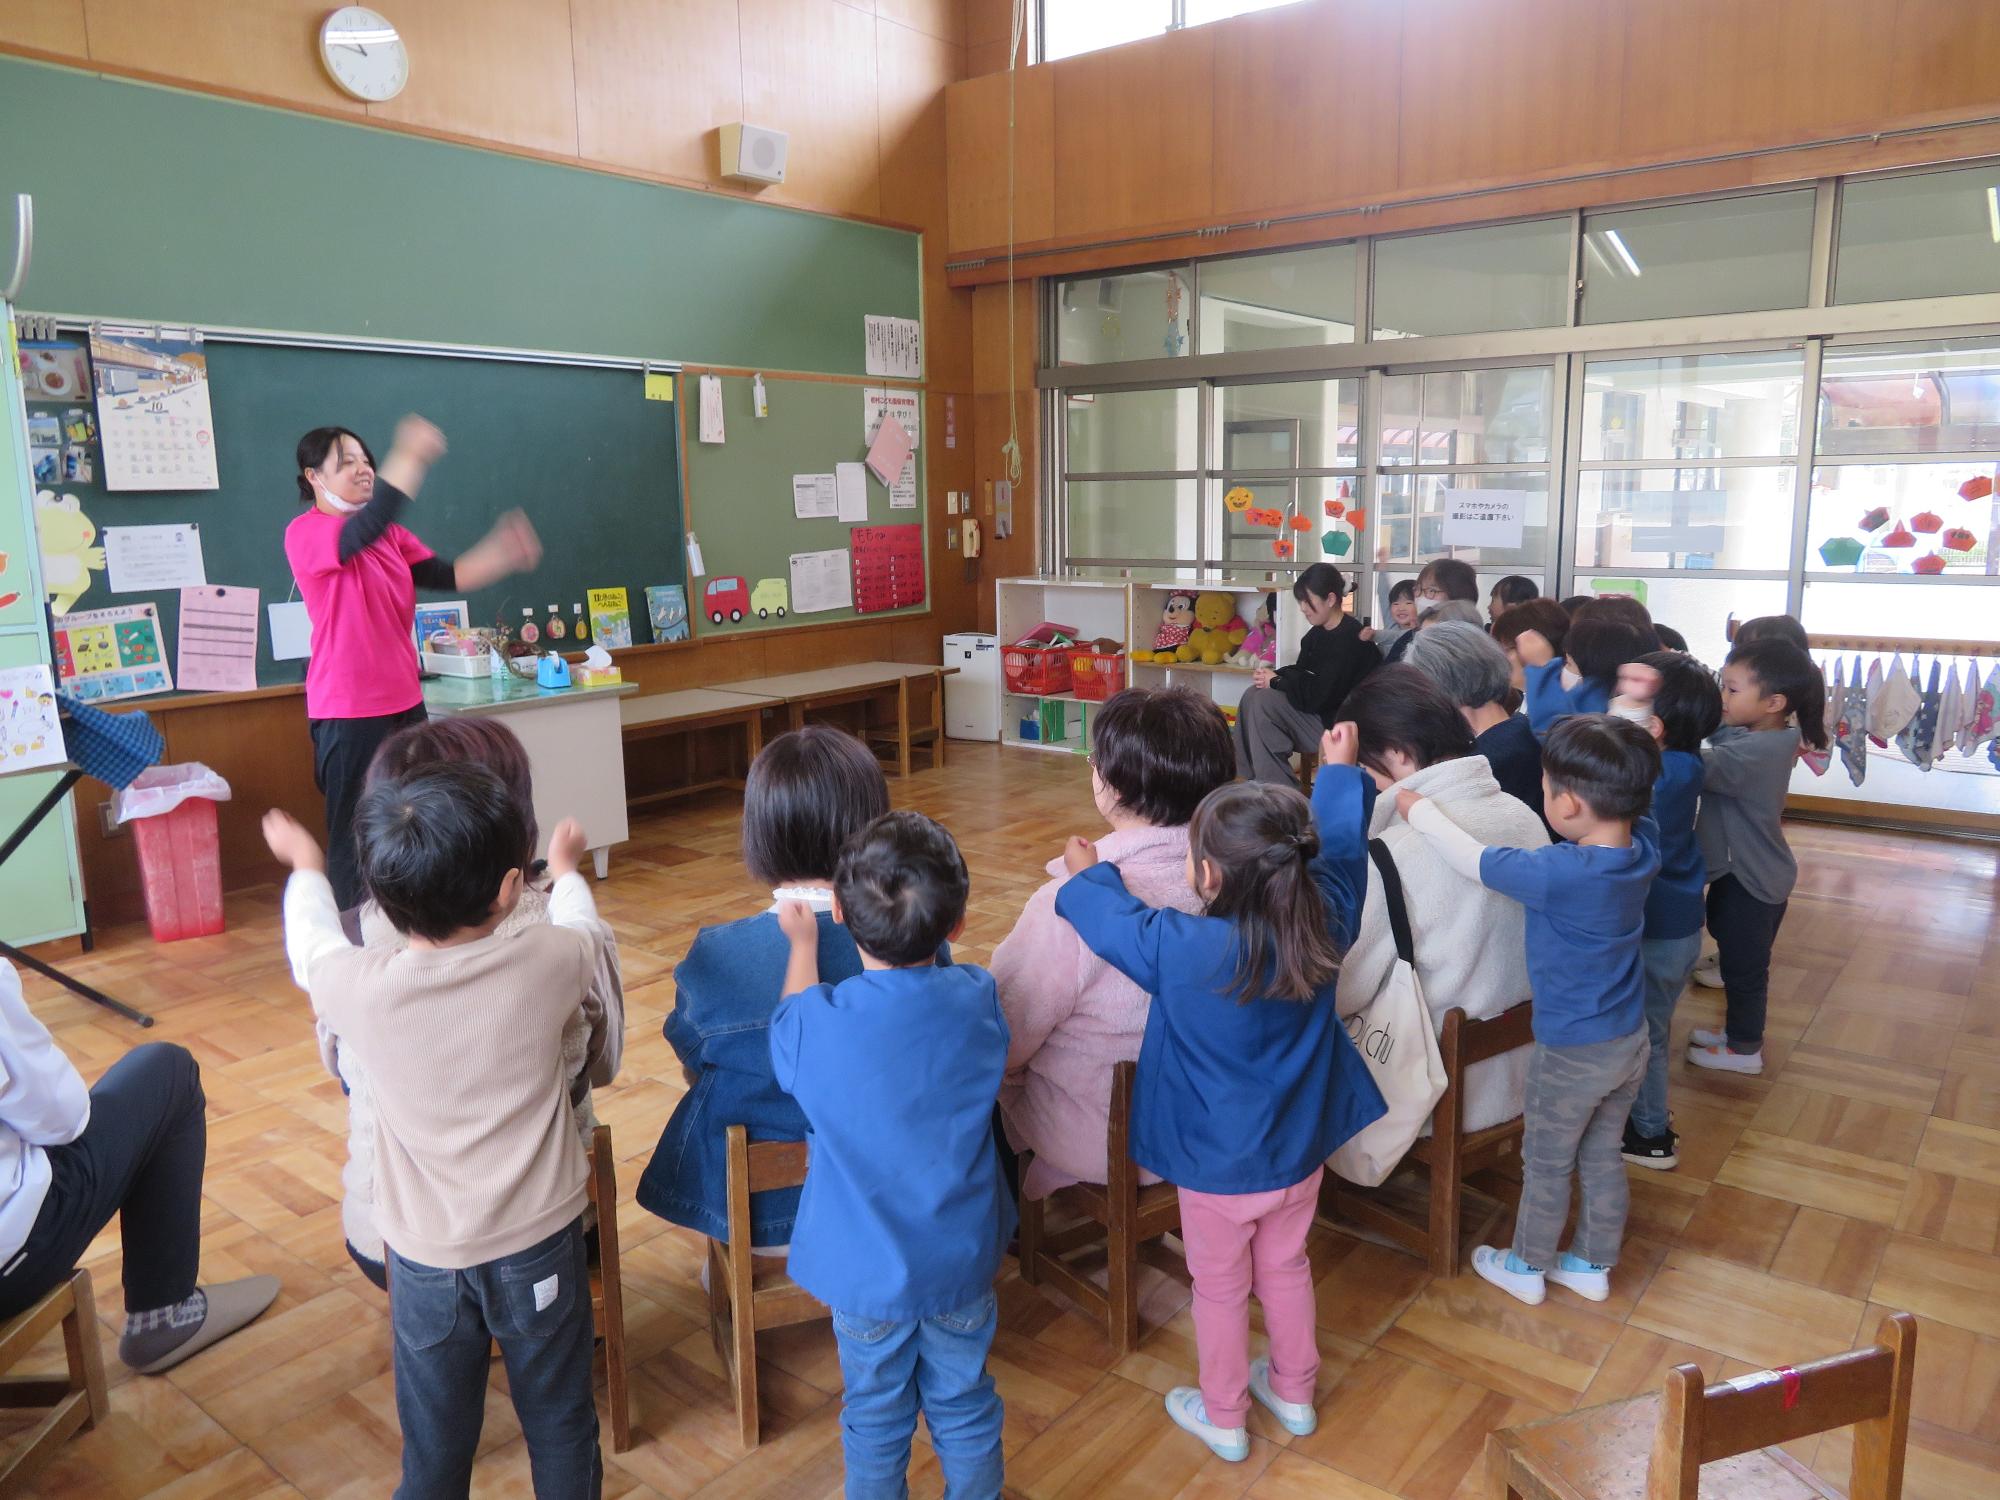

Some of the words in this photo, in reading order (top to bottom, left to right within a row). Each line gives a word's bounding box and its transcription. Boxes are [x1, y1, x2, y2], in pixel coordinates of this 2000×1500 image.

[1458, 502, 1509, 510] スマホやカメラの
[1452, 512, 1514, 521] 撮影はご遠慮下さい
